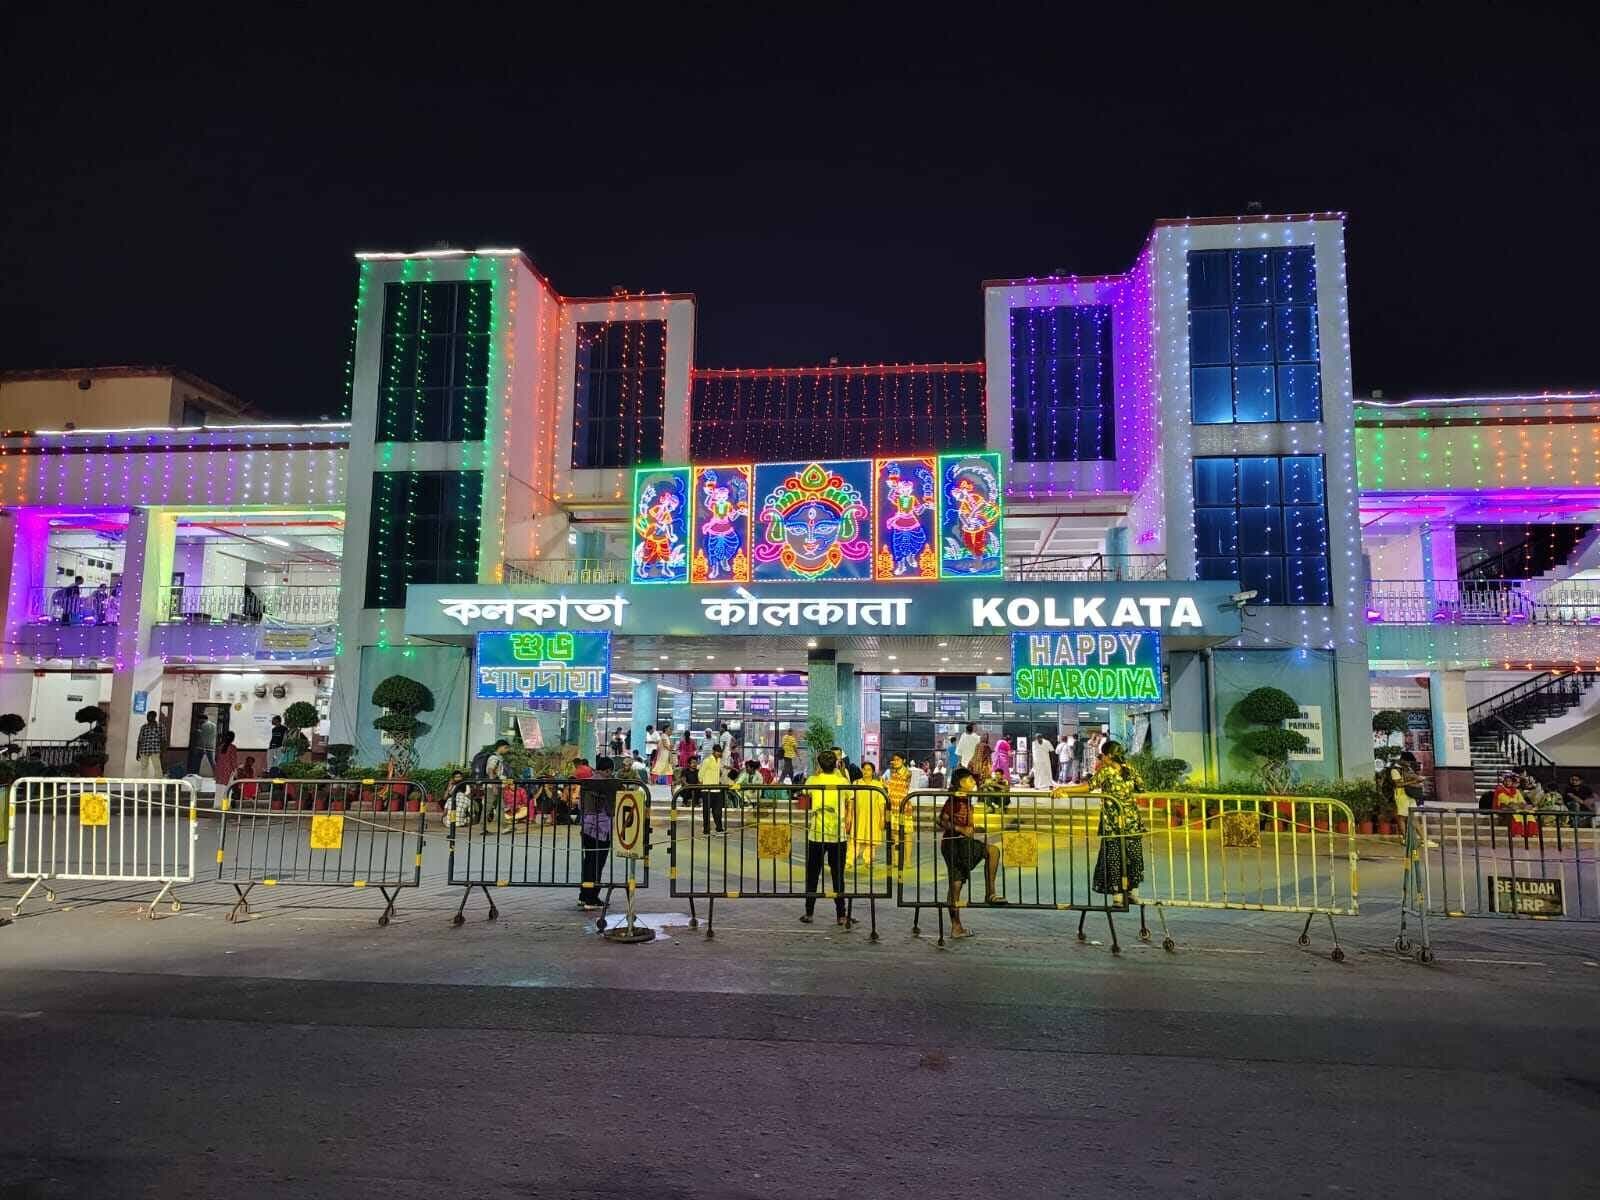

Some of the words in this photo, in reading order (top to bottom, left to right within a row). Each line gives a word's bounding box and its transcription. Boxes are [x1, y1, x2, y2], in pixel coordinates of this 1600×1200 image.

[437, 595, 631, 627] কলকাতা
[701, 587, 913, 627] कोलकाता
[972, 597, 1203, 628] KOLKATA
[509, 632, 574, 661] শুভ
[1028, 633, 1142, 666] HAPPY
[480, 661, 606, 697] শারদীয়া
[1015, 667, 1160, 700] SHARODIYA
[1288, 722, 1320, 730] PARKING
[1496, 880, 1555, 895] SEALDAH
